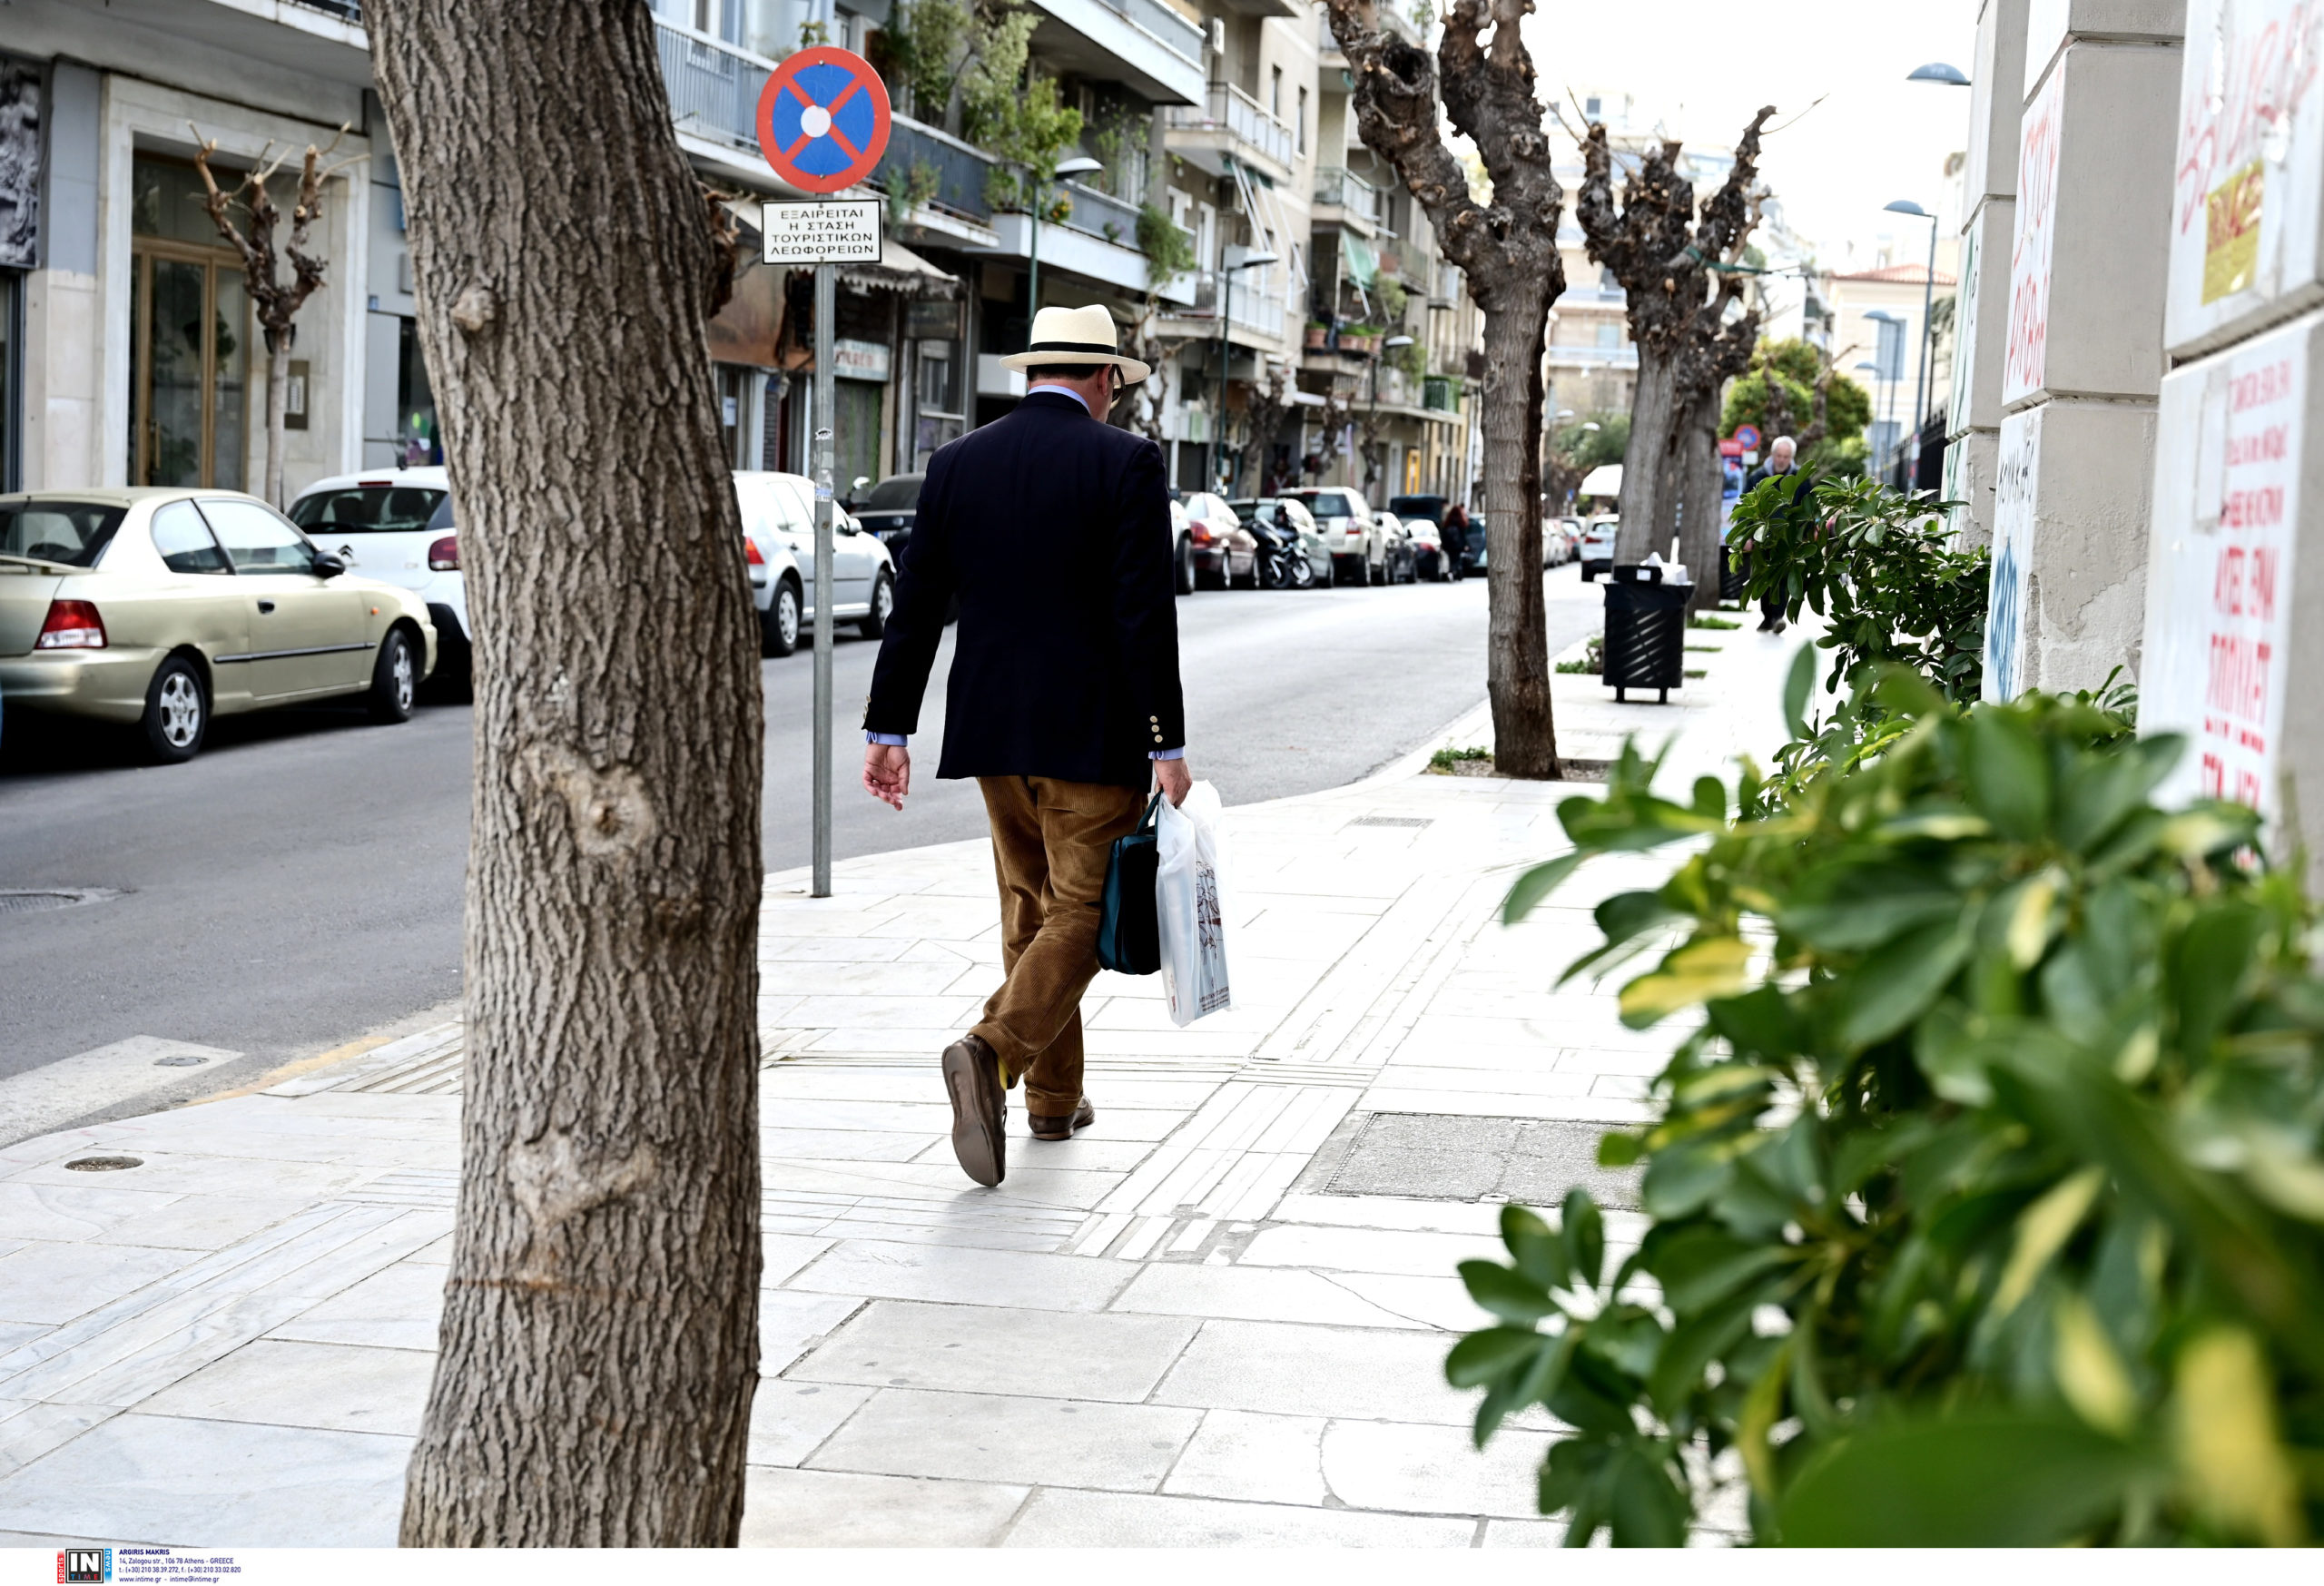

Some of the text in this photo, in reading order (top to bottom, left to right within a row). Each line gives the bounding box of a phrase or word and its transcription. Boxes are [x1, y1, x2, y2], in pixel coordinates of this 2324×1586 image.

[2014, 65, 2063, 268] STOP
[781, 209, 863, 219] ΕΞΑΙΡΕΙΤΑΙ
[789, 221, 854, 231] Η ΣΤΑΣΗ
[772, 232, 872, 243] ΤΟΥΡΙΣΤΙΚΩΝ
[771, 245, 873, 255] ΛΕΩΦΟΡΕΙΩΝ
